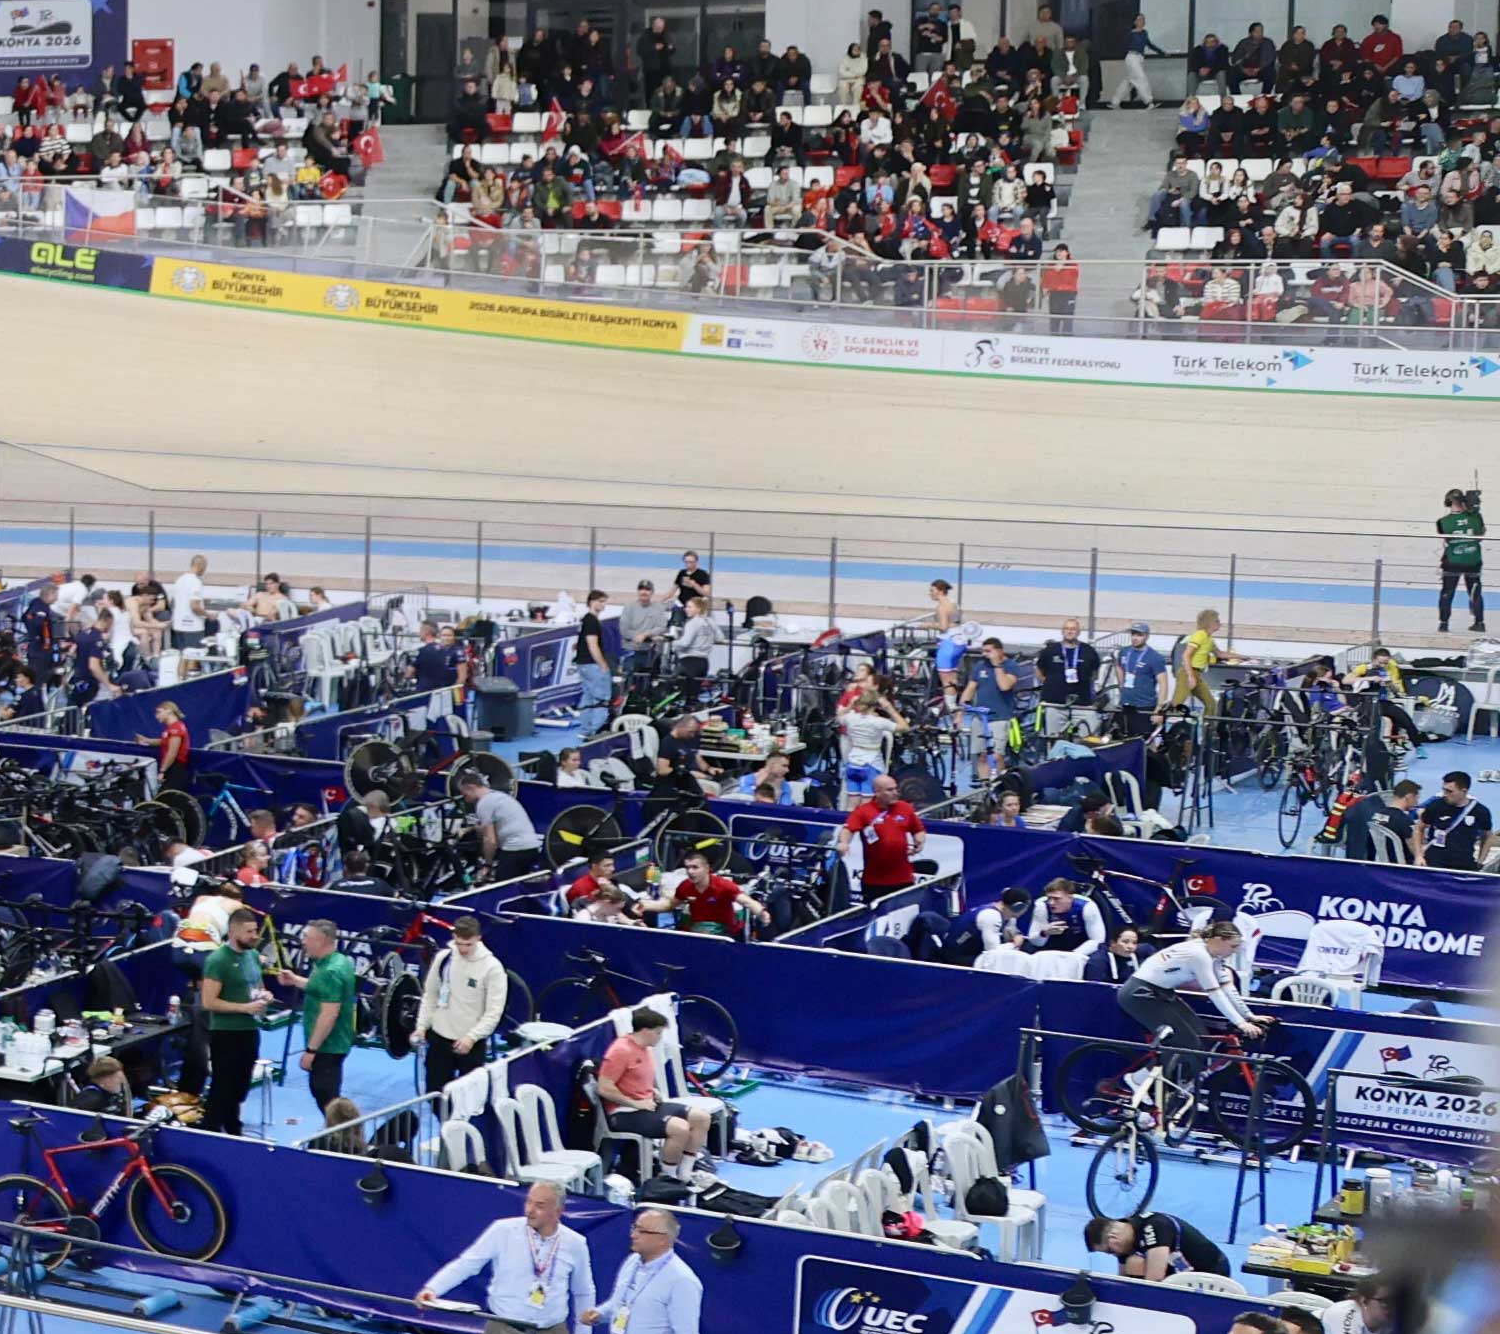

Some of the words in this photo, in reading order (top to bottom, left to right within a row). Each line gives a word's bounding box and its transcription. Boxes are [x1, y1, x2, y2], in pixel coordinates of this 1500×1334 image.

[45, 35, 81, 47] 2026
[232, 271, 266, 283] KONYA
[212, 281, 283, 297] BÜYÜKŞEHİR
[385, 288, 421, 299] KONYA
[365, 297, 438, 314] BÜYÜKŞEHİR
[497, 304, 537, 317] AVRUPA
[906, 339, 919, 347] VE
[1010, 344, 1050, 355] TÜRKİYE
[844, 345, 867, 355] SPOR
[1052, 358, 1121, 370] FEDERASYONU
[1172, 355, 1207, 369] Türk
[1213, 357, 1282, 372] Telekom
[1353, 362, 1389, 376] Türk
[1396, 364, 1469, 379] Telekom
[1317, 895, 1427, 928] KONYA
[1355, 1085, 1428, 1110] KONYA
[1434, 1095, 1498, 1117] 2026
[862, 1307, 928, 1334] UEC
